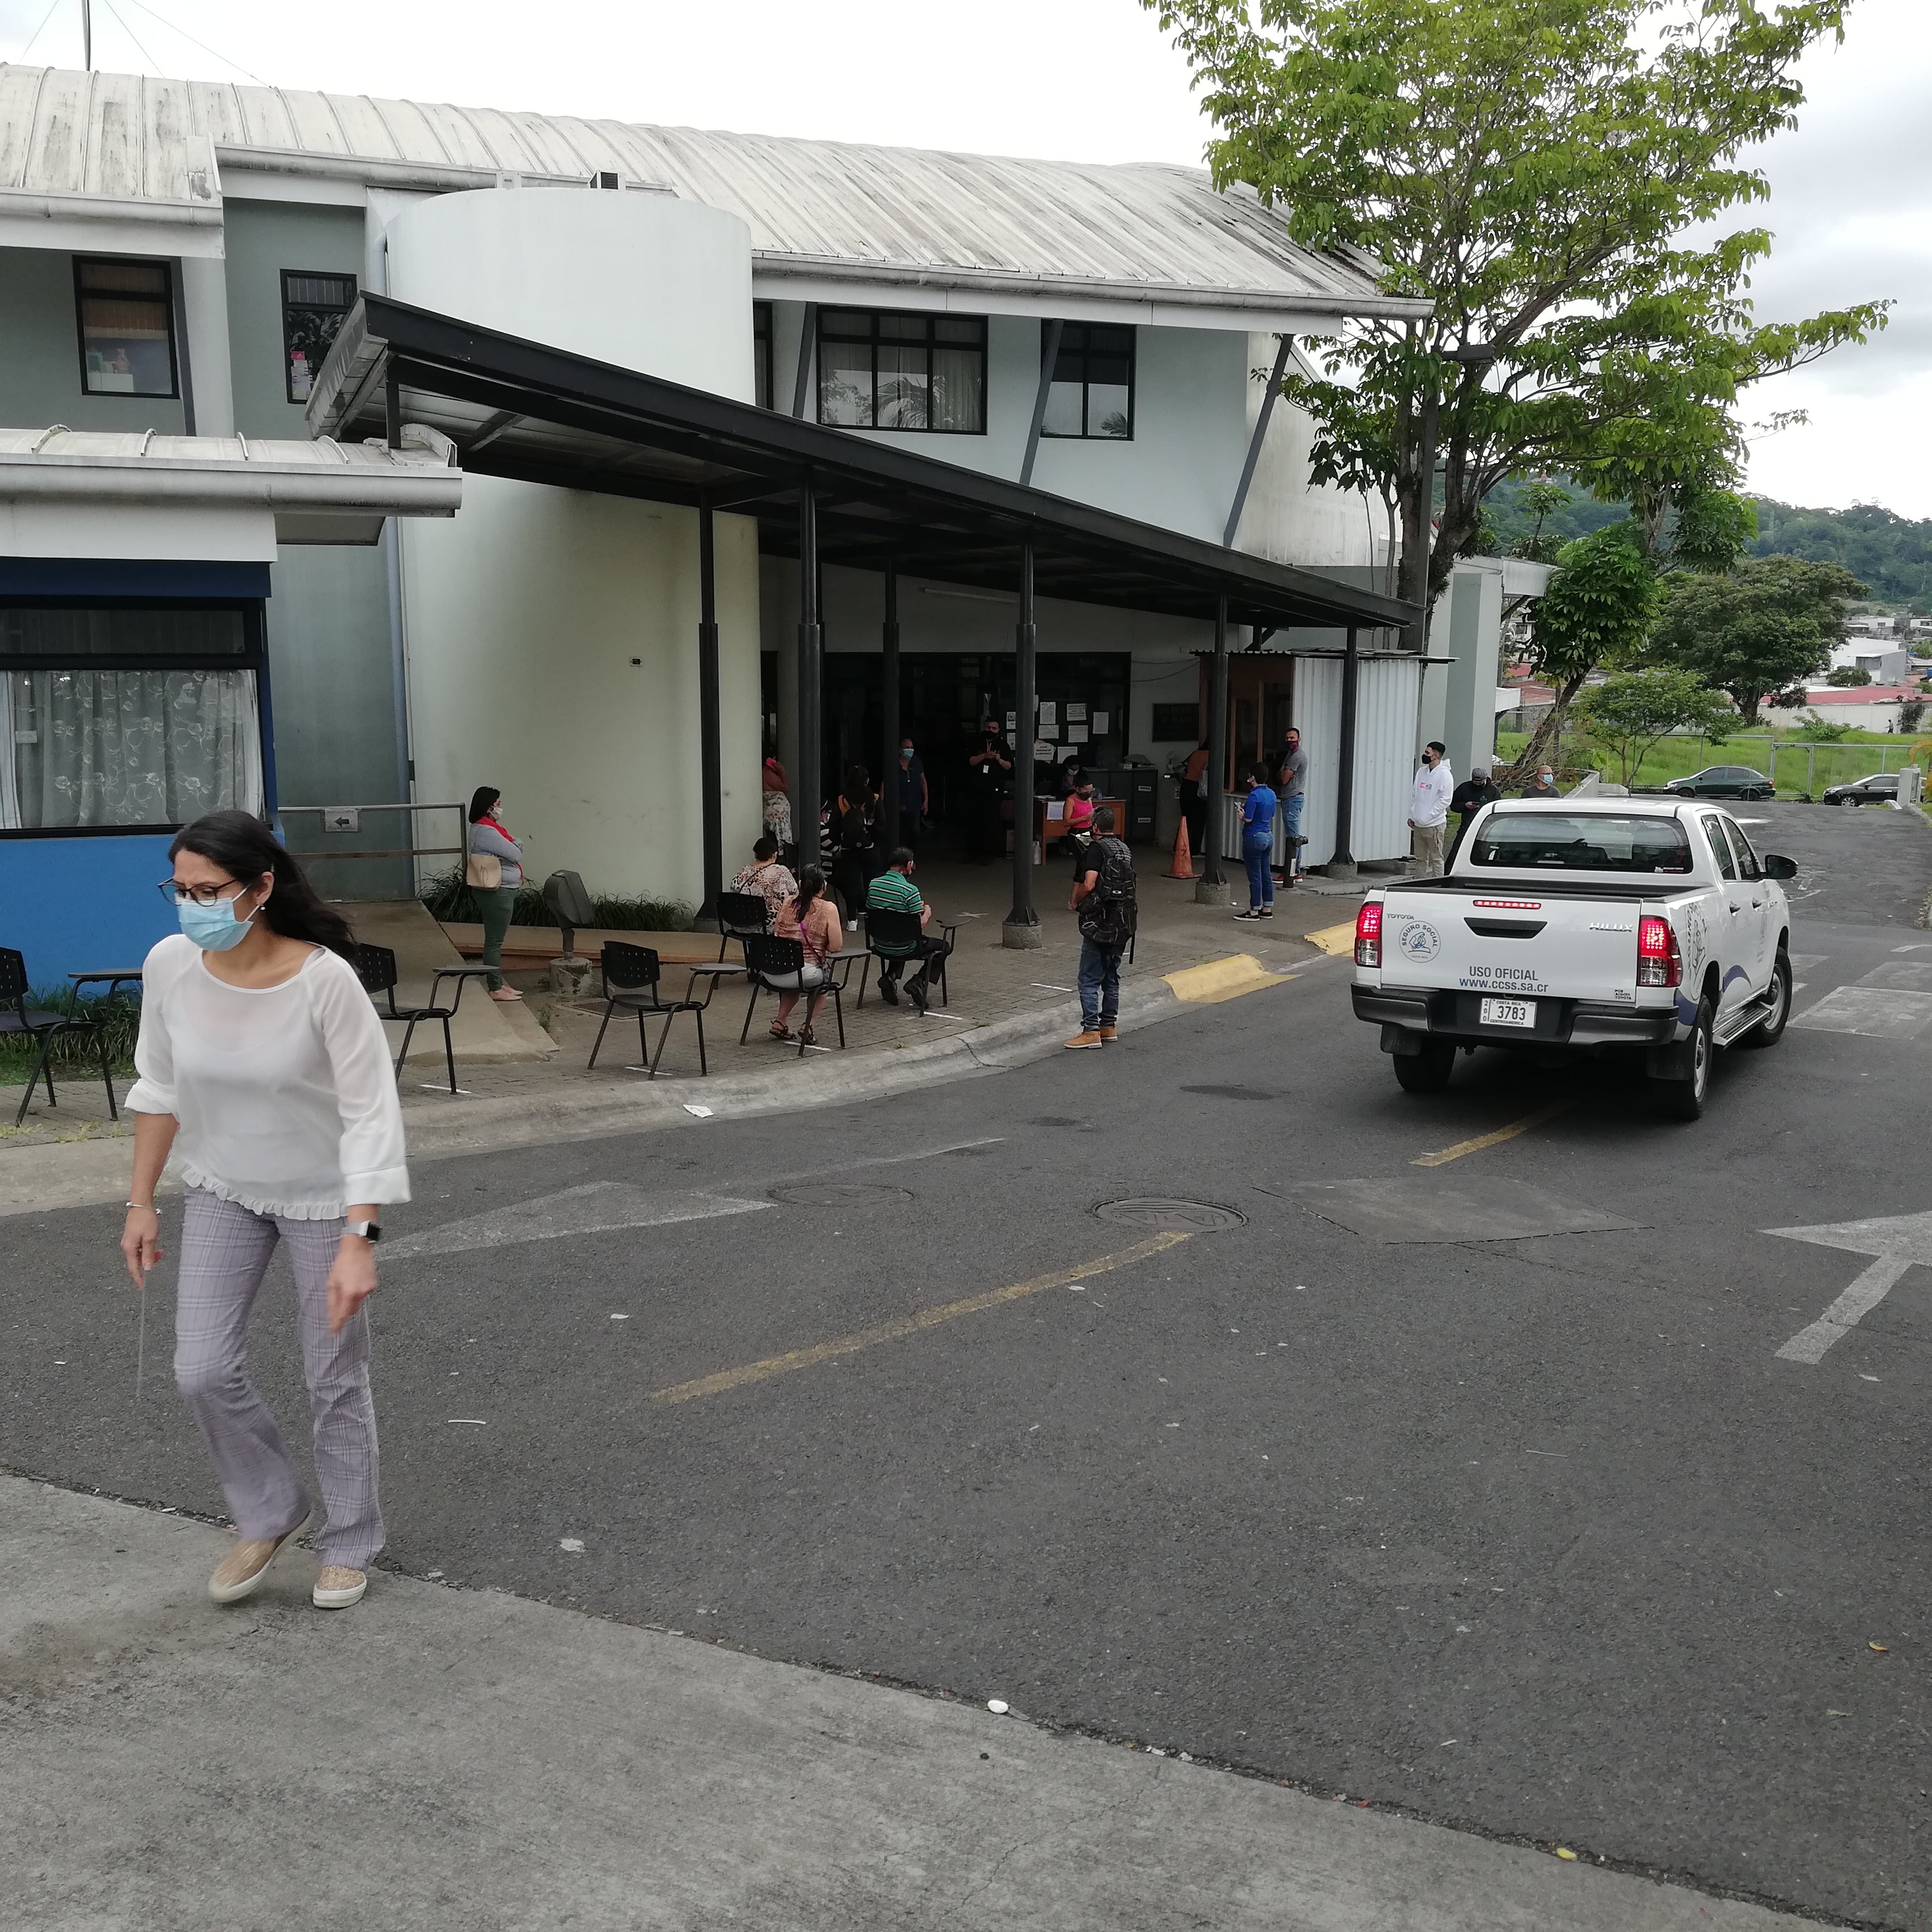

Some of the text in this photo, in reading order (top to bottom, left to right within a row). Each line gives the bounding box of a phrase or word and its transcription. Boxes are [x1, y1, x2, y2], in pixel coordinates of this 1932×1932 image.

[1401, 924, 1438, 948] SEGURO SOCIAL
[1469, 966, 1538, 981] USO OFICIAL
[1459, 978, 1549, 992] www.ccss.sa.cr
[1497, 1006, 1526, 1020] 3783
